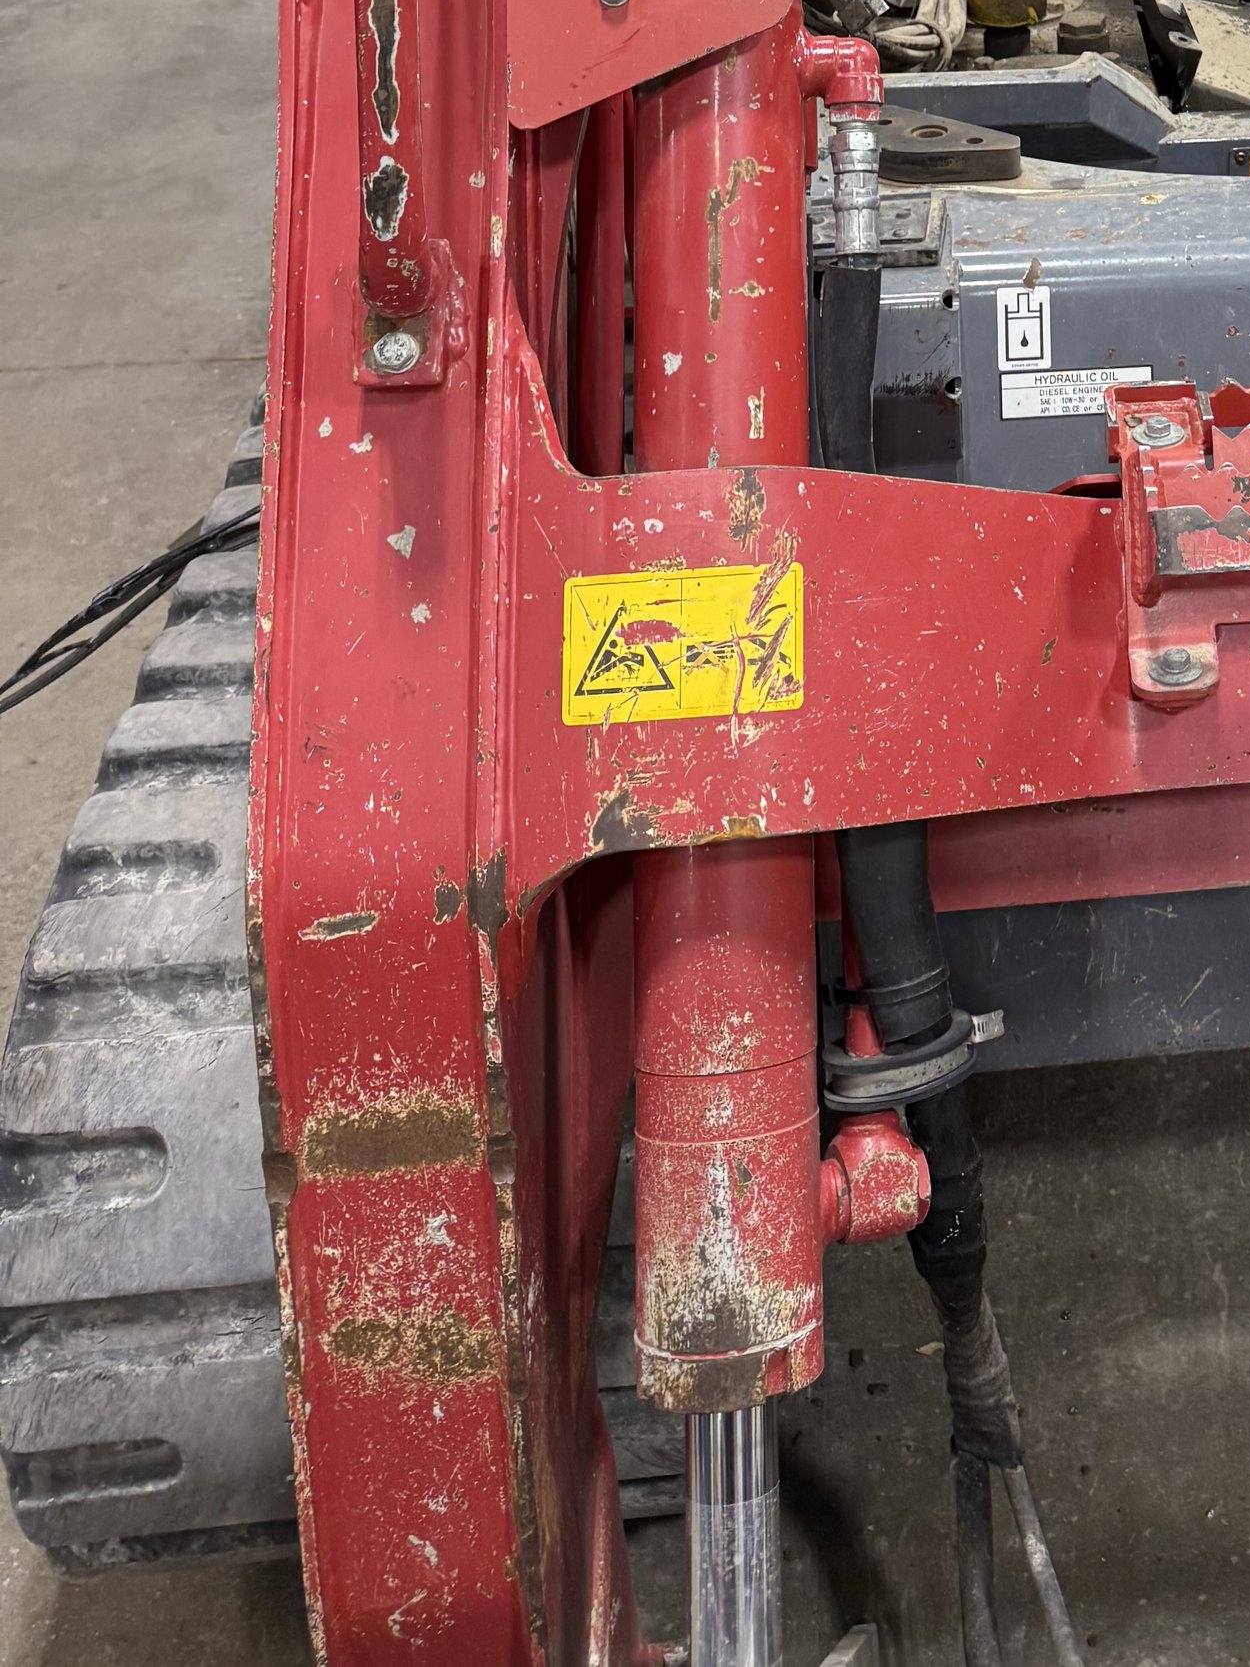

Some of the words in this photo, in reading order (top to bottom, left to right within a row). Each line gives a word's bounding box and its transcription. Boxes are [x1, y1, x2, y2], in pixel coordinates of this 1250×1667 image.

[1034, 372, 1097, 385] HYDRAULIC
[1100, 371, 1119, 381] OIL
[1039, 388, 1069, 396] DIESEL
[1072, 386, 1104, 394] ENGINE
